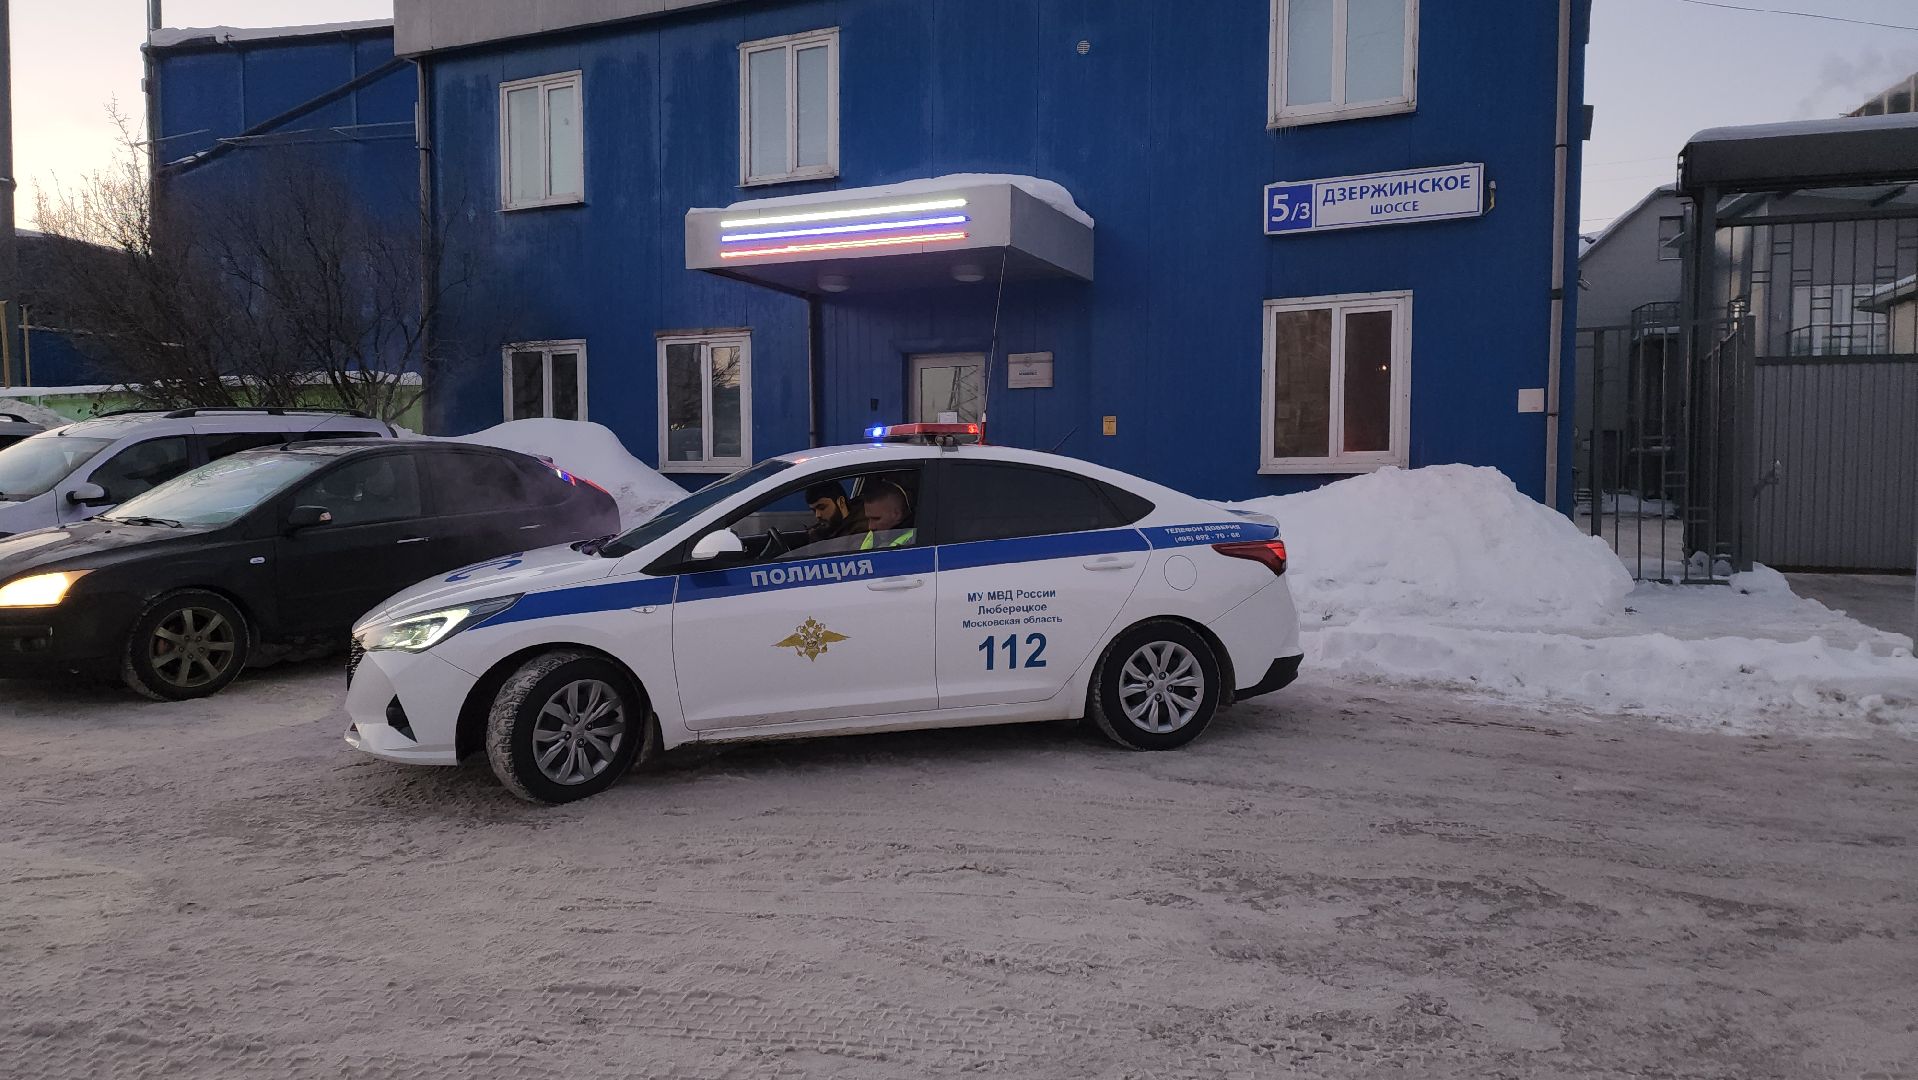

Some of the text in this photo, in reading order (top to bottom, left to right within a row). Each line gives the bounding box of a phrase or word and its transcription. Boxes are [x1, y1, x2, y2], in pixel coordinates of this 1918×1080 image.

[1271, 174, 1471, 222] 5/3 ДЗЕРЖИНСКОЕ
[1370, 200, 1420, 215] ШОССЕ
[1165, 524, 1241, 534] ТЕЛЕФОН ДОВЕРИЯ
[750, 559, 874, 587] ПОЛИЦИЯ
[967, 589, 1056, 602] МУ МВД России
[977, 603, 1048, 615] Люберецкое
[962, 615, 1063, 628] Московская область
[978, 632, 1047, 670] 112
